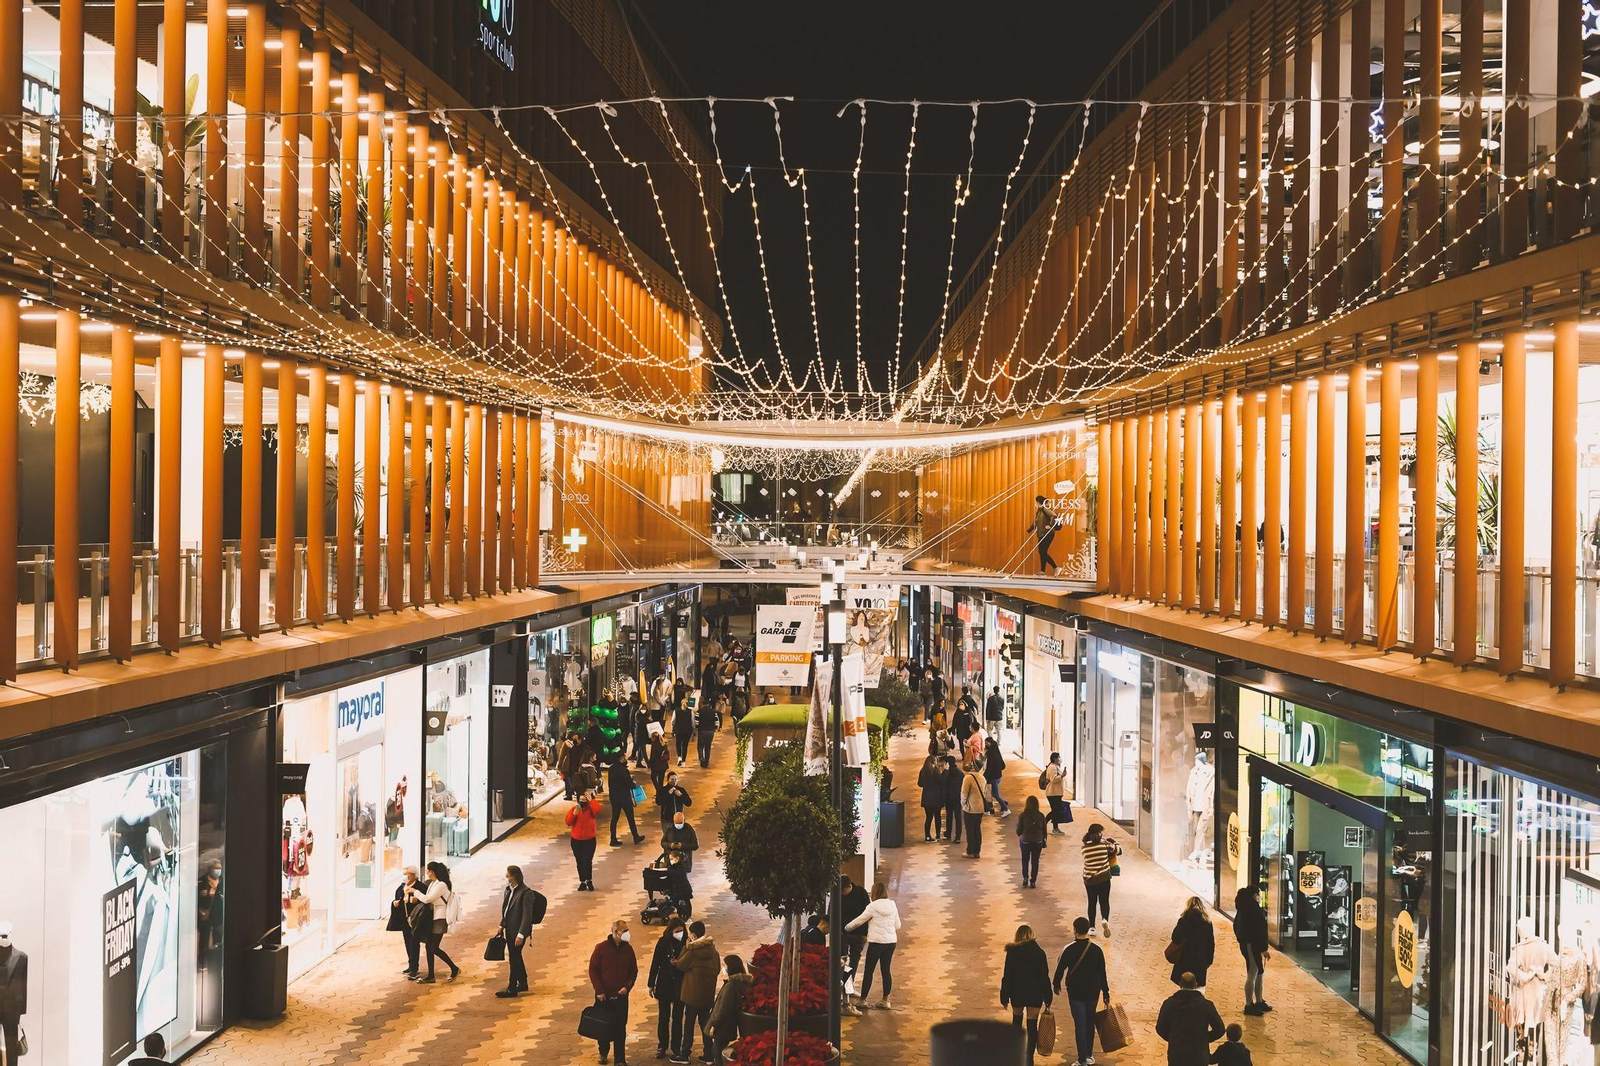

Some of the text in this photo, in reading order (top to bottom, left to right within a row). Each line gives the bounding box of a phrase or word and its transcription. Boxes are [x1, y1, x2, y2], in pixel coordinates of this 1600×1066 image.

[1043, 498, 1081, 510] GUESS
[1055, 513, 1075, 526] H&M
[770, 654, 804, 662] PARKING
[338, 681, 384, 732] mayoral
[1200, 731, 1211, 739] JD
[1296, 721, 1316, 767] JD
[105, 886, 135, 932] BLACK
[105, 917, 135, 965] FRIDAY
[1398, 924, 1413, 943] BLACK
[1398, 935, 1413, 953] FRIDAY
[1399, 946, 1413, 968] 50%
